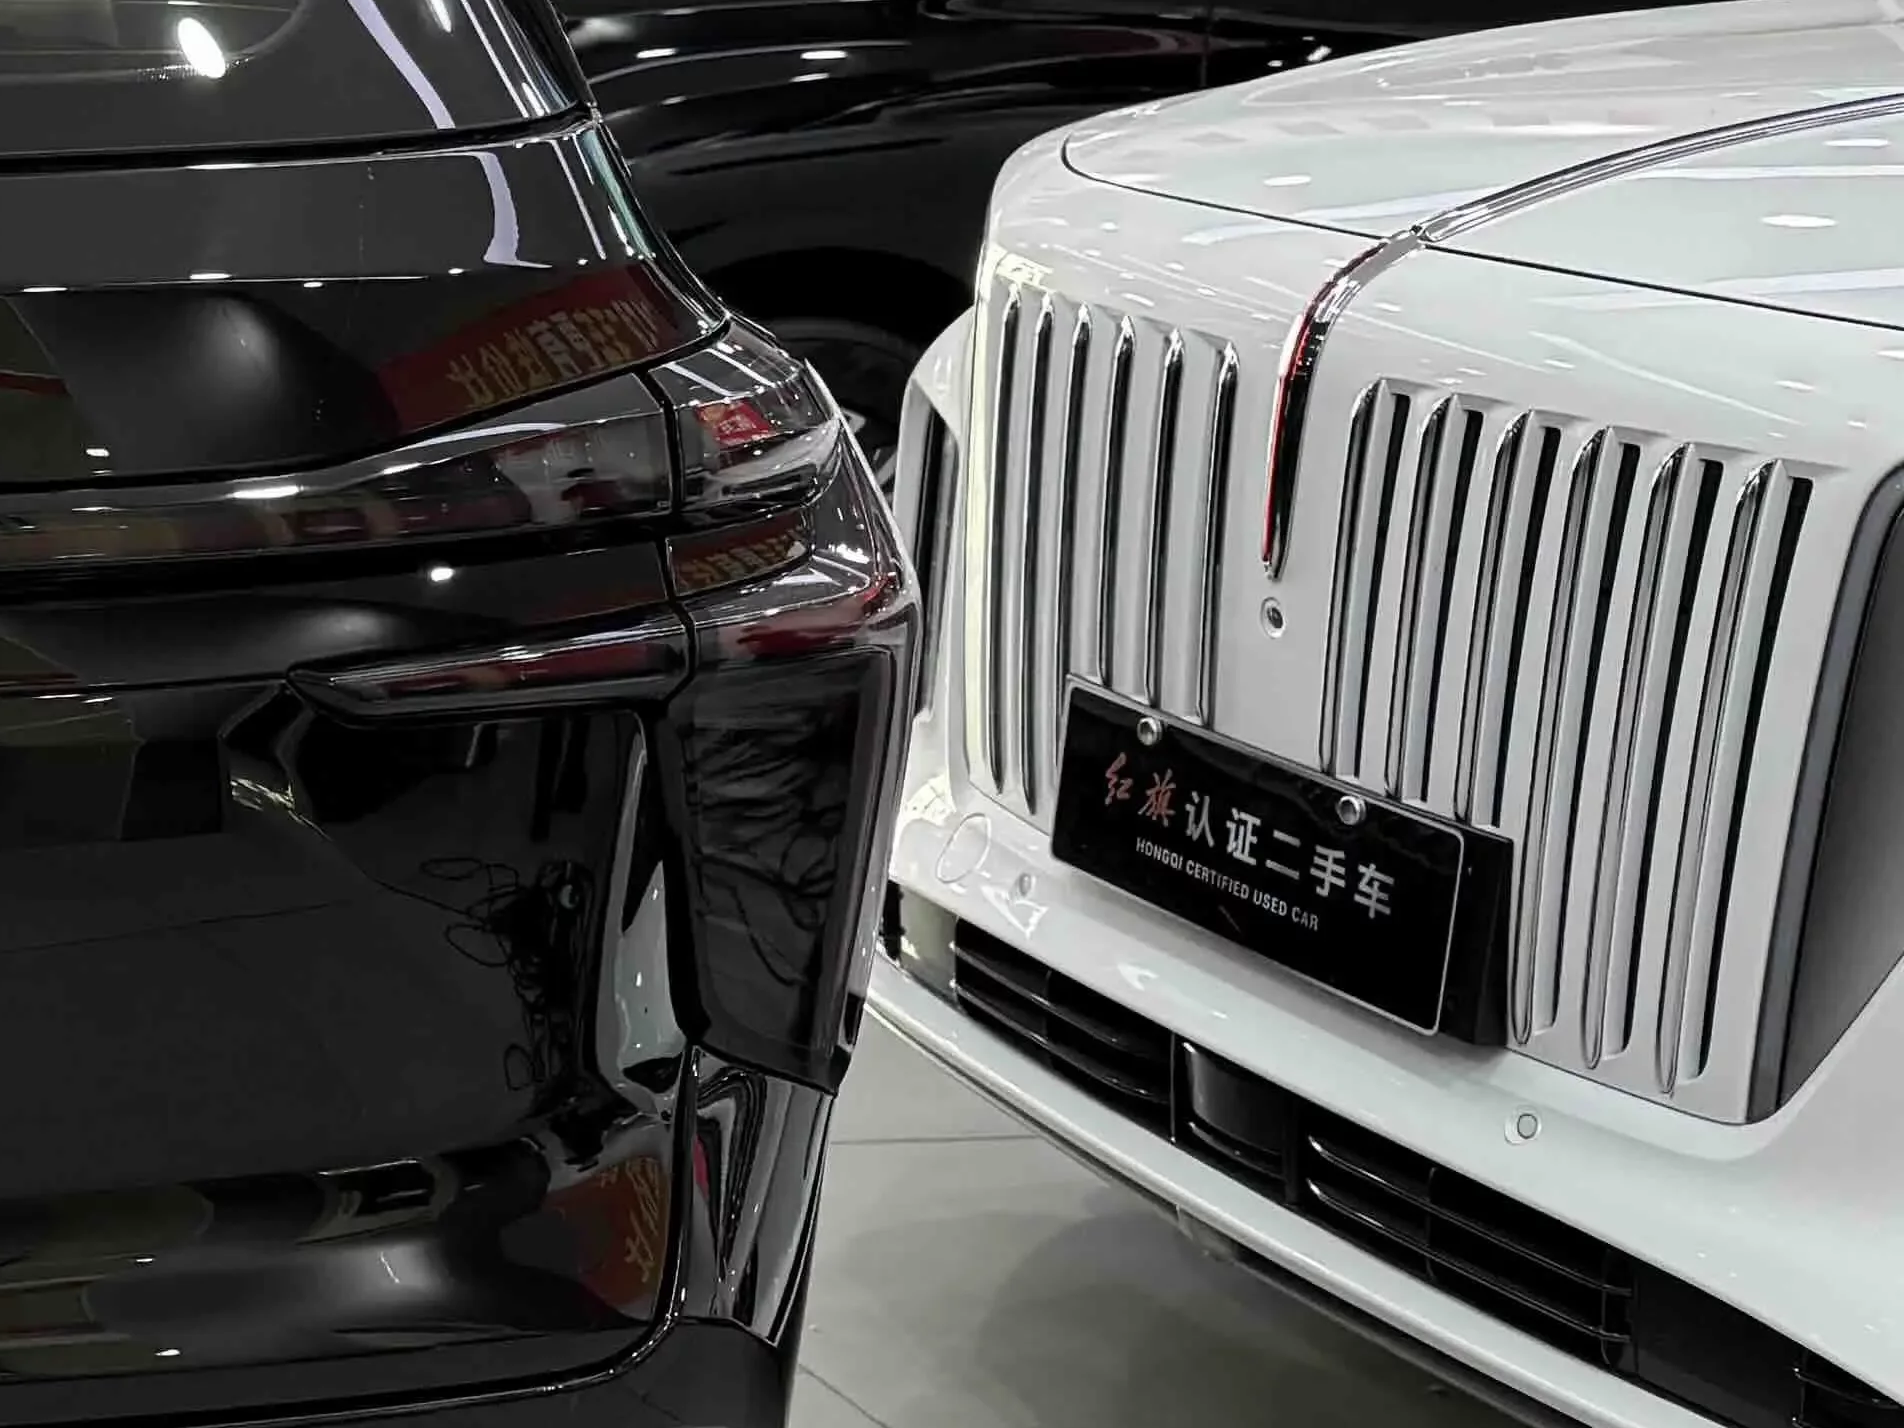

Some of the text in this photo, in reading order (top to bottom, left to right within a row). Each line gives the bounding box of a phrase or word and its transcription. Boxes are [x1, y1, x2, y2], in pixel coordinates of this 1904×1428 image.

[1135, 836, 1320, 931] HONGQI CERTIFIED USED CAR
